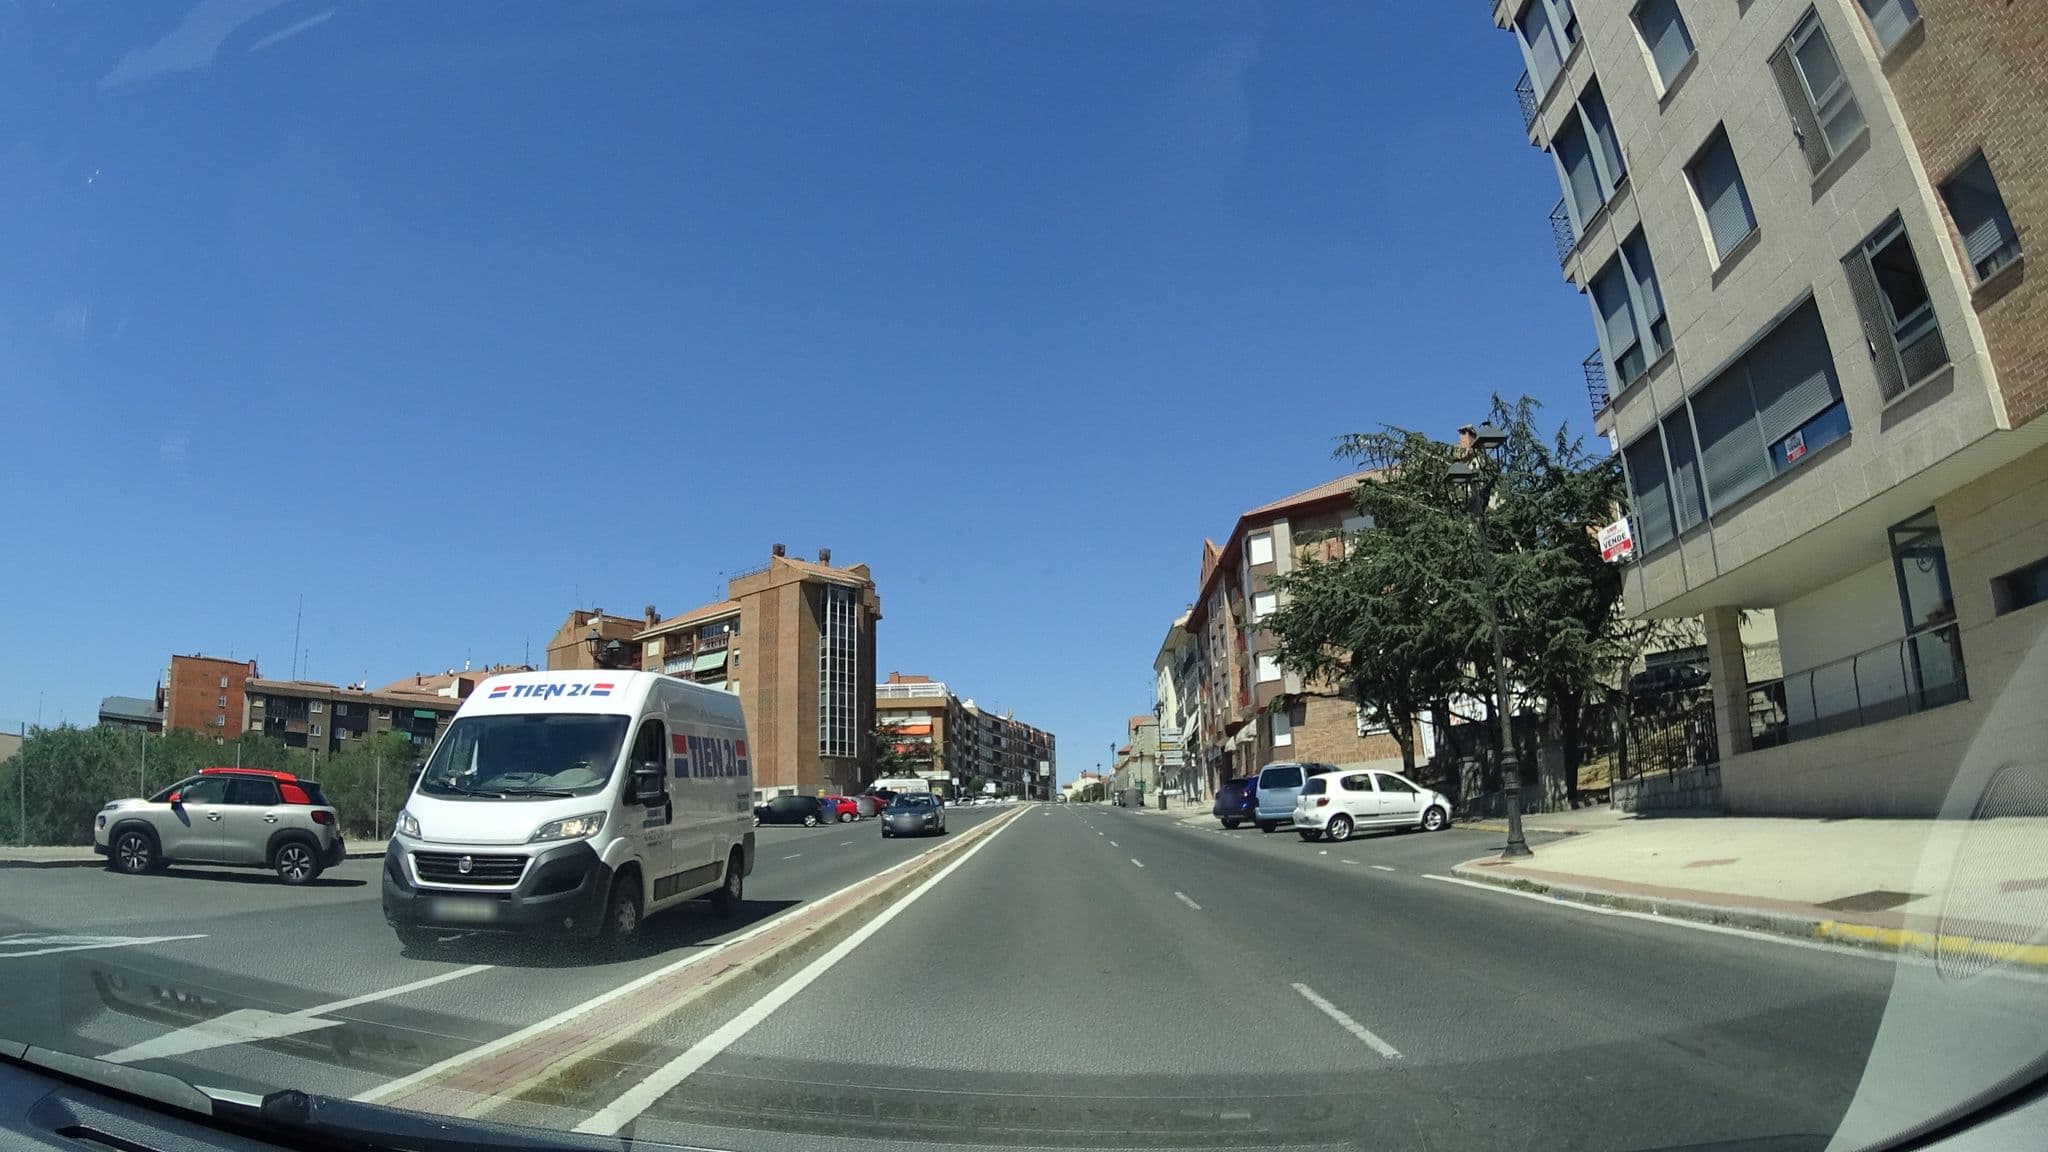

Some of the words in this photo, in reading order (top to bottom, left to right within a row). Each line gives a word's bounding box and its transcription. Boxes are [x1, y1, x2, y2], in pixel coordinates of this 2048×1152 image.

[1603, 531, 1626, 549] VENDE
[512, 683, 566, 699] TIEN
[567, 683, 591, 696] 21
[688, 735, 724, 778] TIEN
[722, 738, 737, 777] 21
